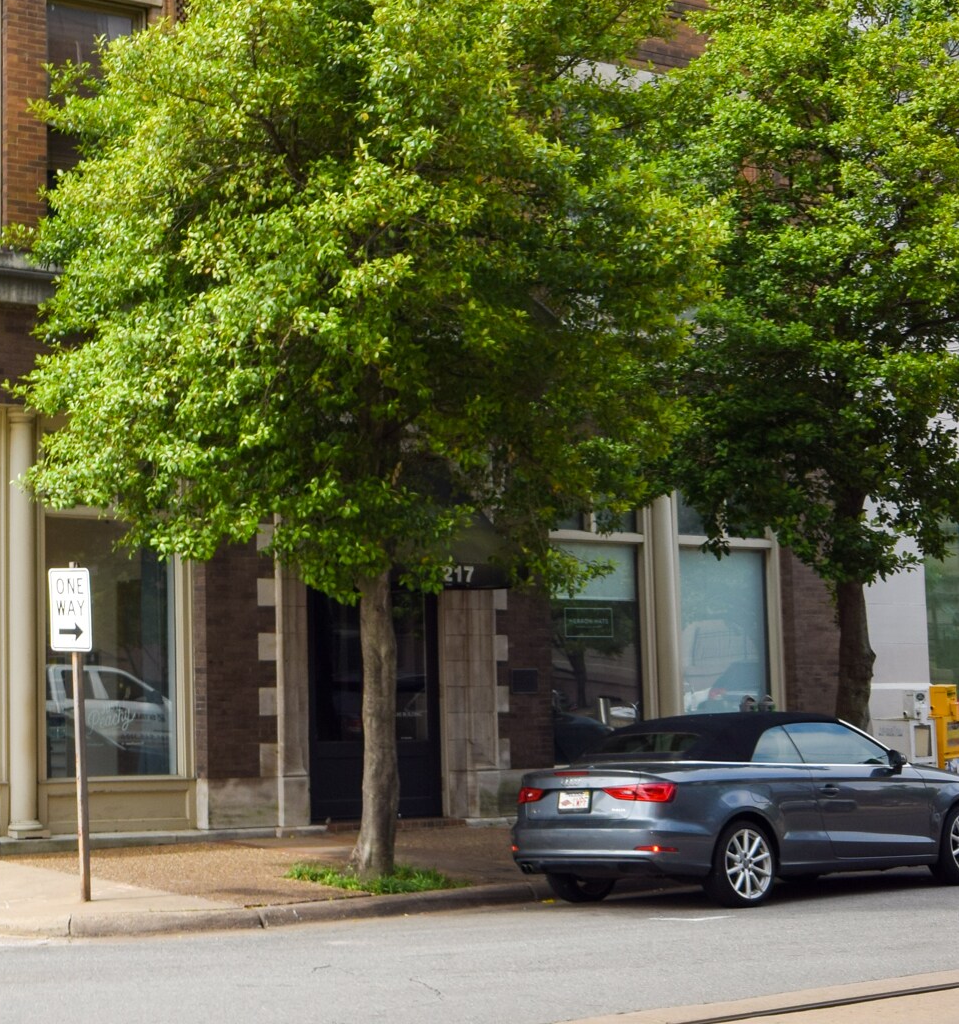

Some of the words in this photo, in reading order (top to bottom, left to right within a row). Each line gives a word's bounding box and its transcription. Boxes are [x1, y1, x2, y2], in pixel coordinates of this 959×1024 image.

[441, 565, 475, 583] 217
[56, 578, 84, 595] ONE
[56, 600, 85, 616] WAY
